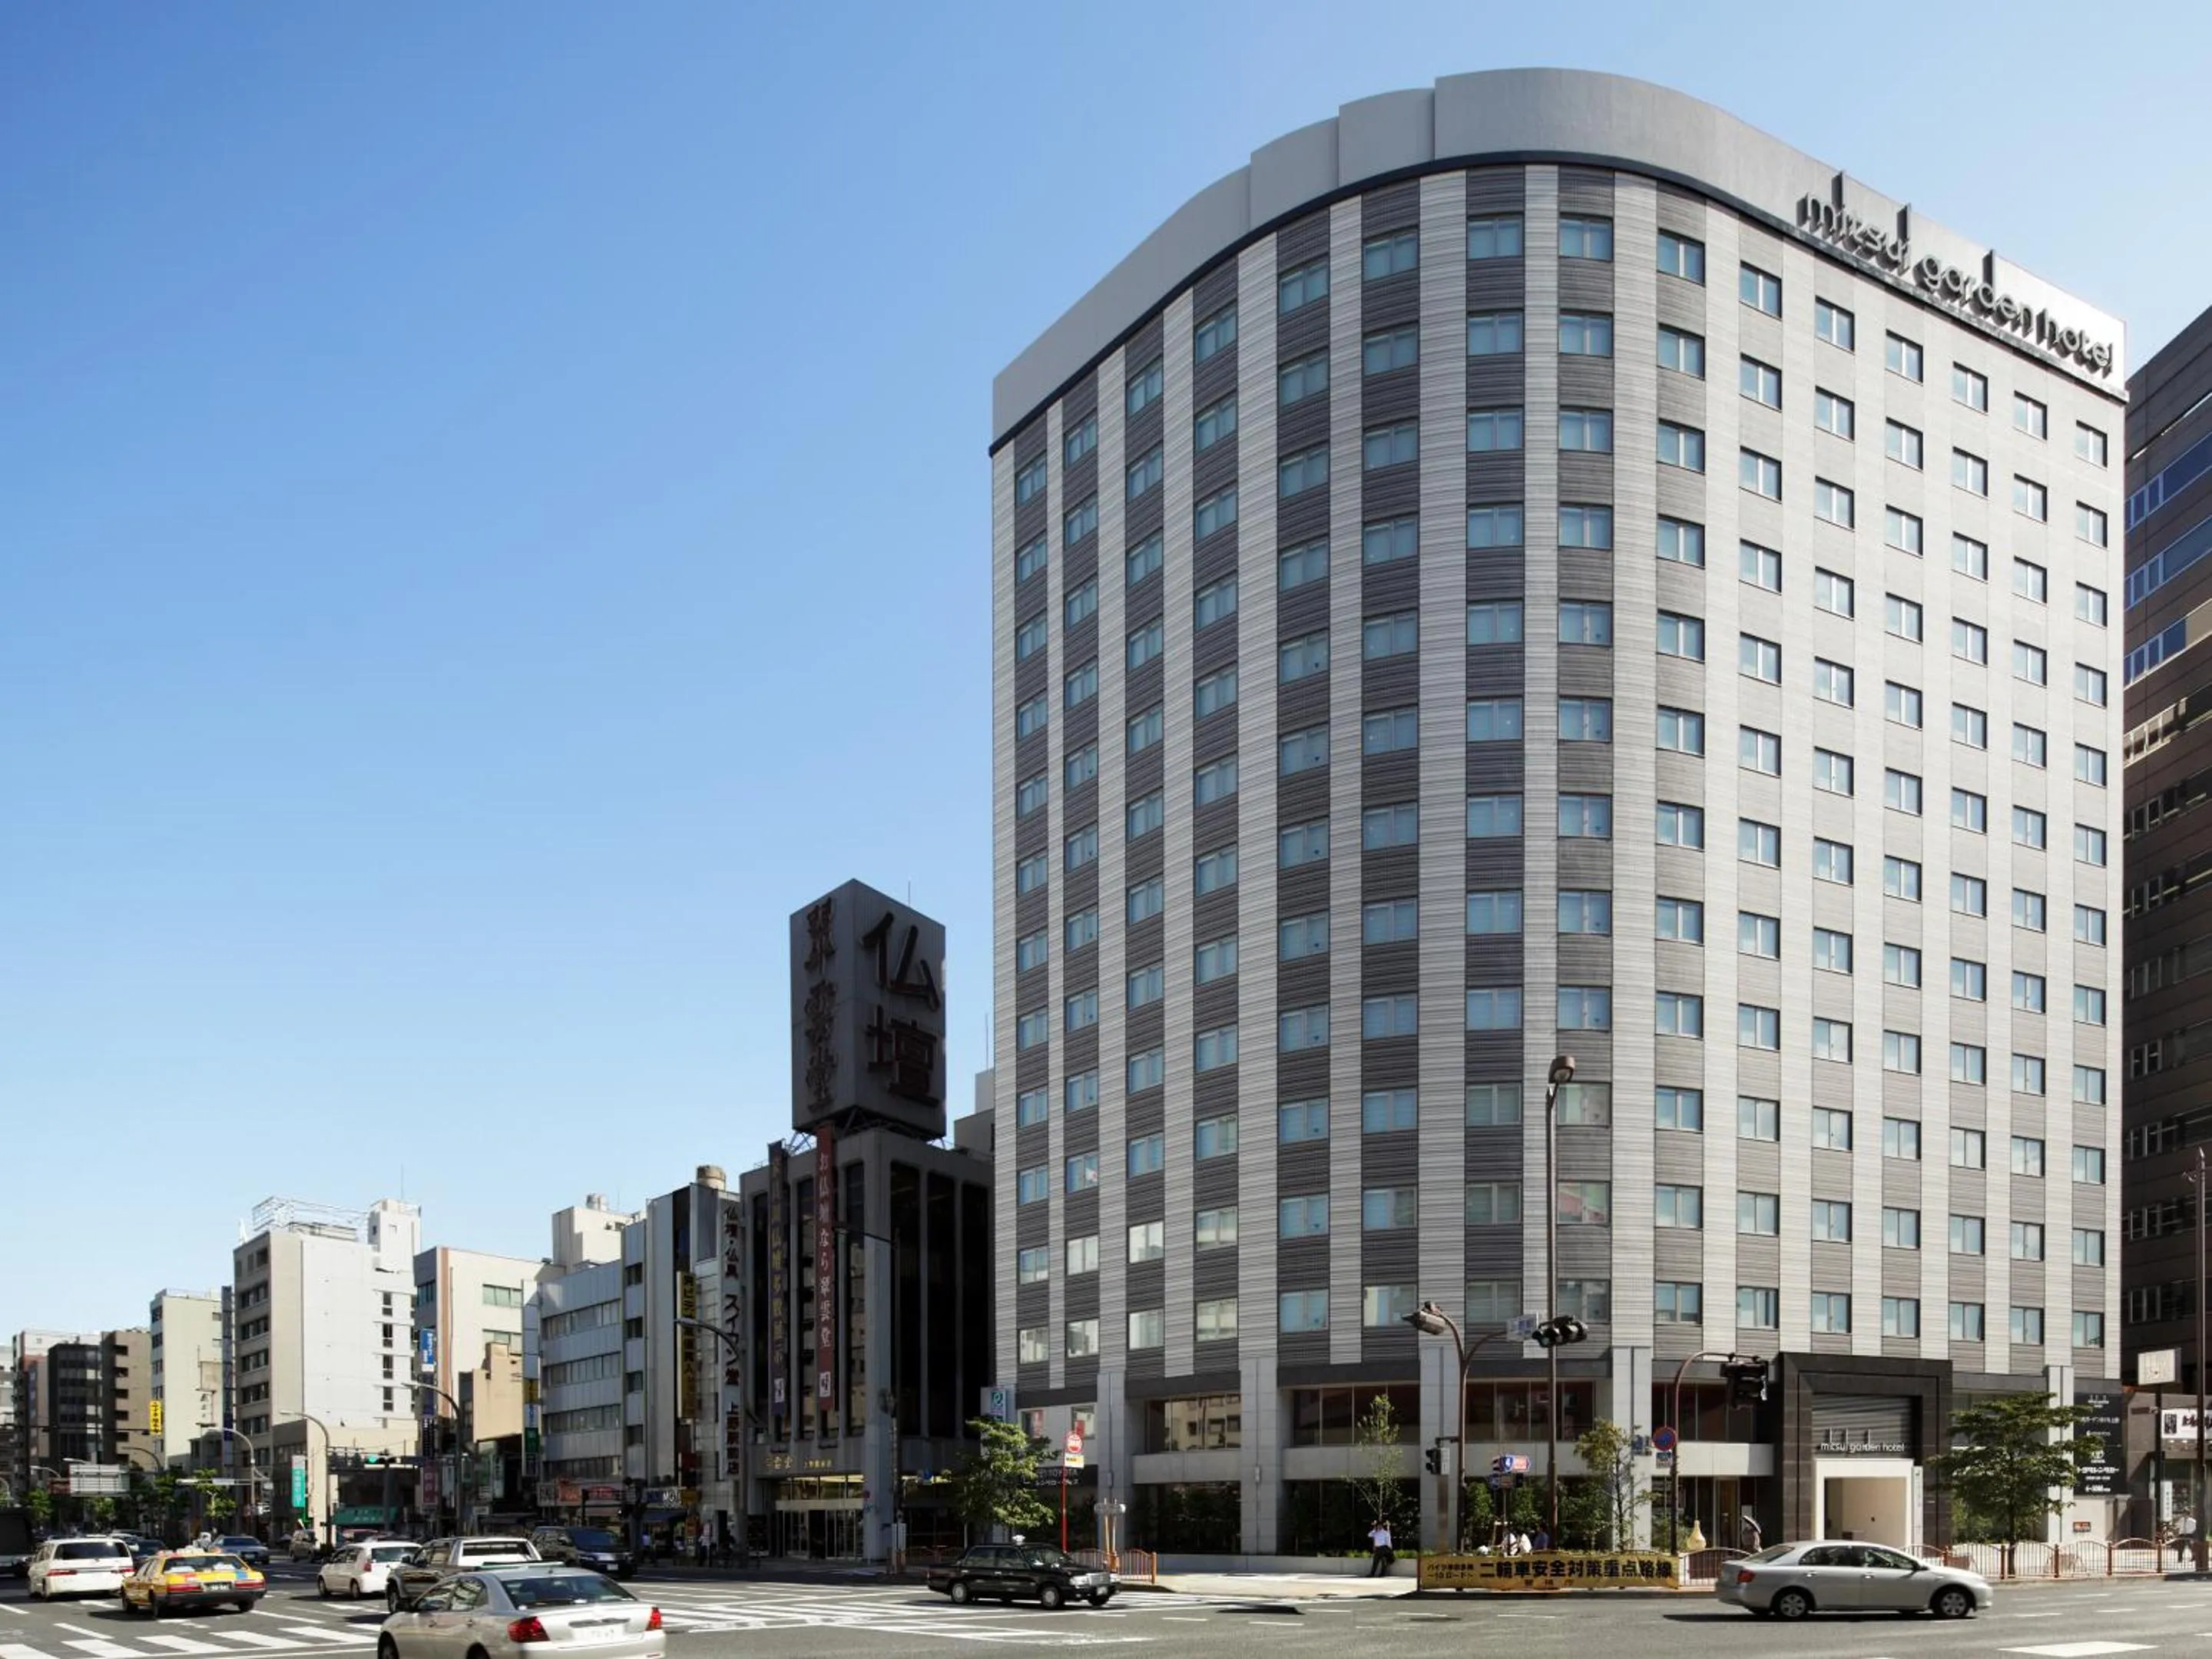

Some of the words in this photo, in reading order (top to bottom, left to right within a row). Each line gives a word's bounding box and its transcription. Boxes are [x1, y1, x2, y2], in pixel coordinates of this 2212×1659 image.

[1798, 171, 1912, 274] mitsui
[1916, 250, 2034, 336] garden
[2037, 308, 2114, 376] hotel
[1820, 1427, 1848, 1451] mitsui
[1849, 1429, 1881, 1453] garden
[1883, 1442, 1905, 1452] hotel
[1479, 1560, 1673, 1578] 二輪車安全対策重点路線
